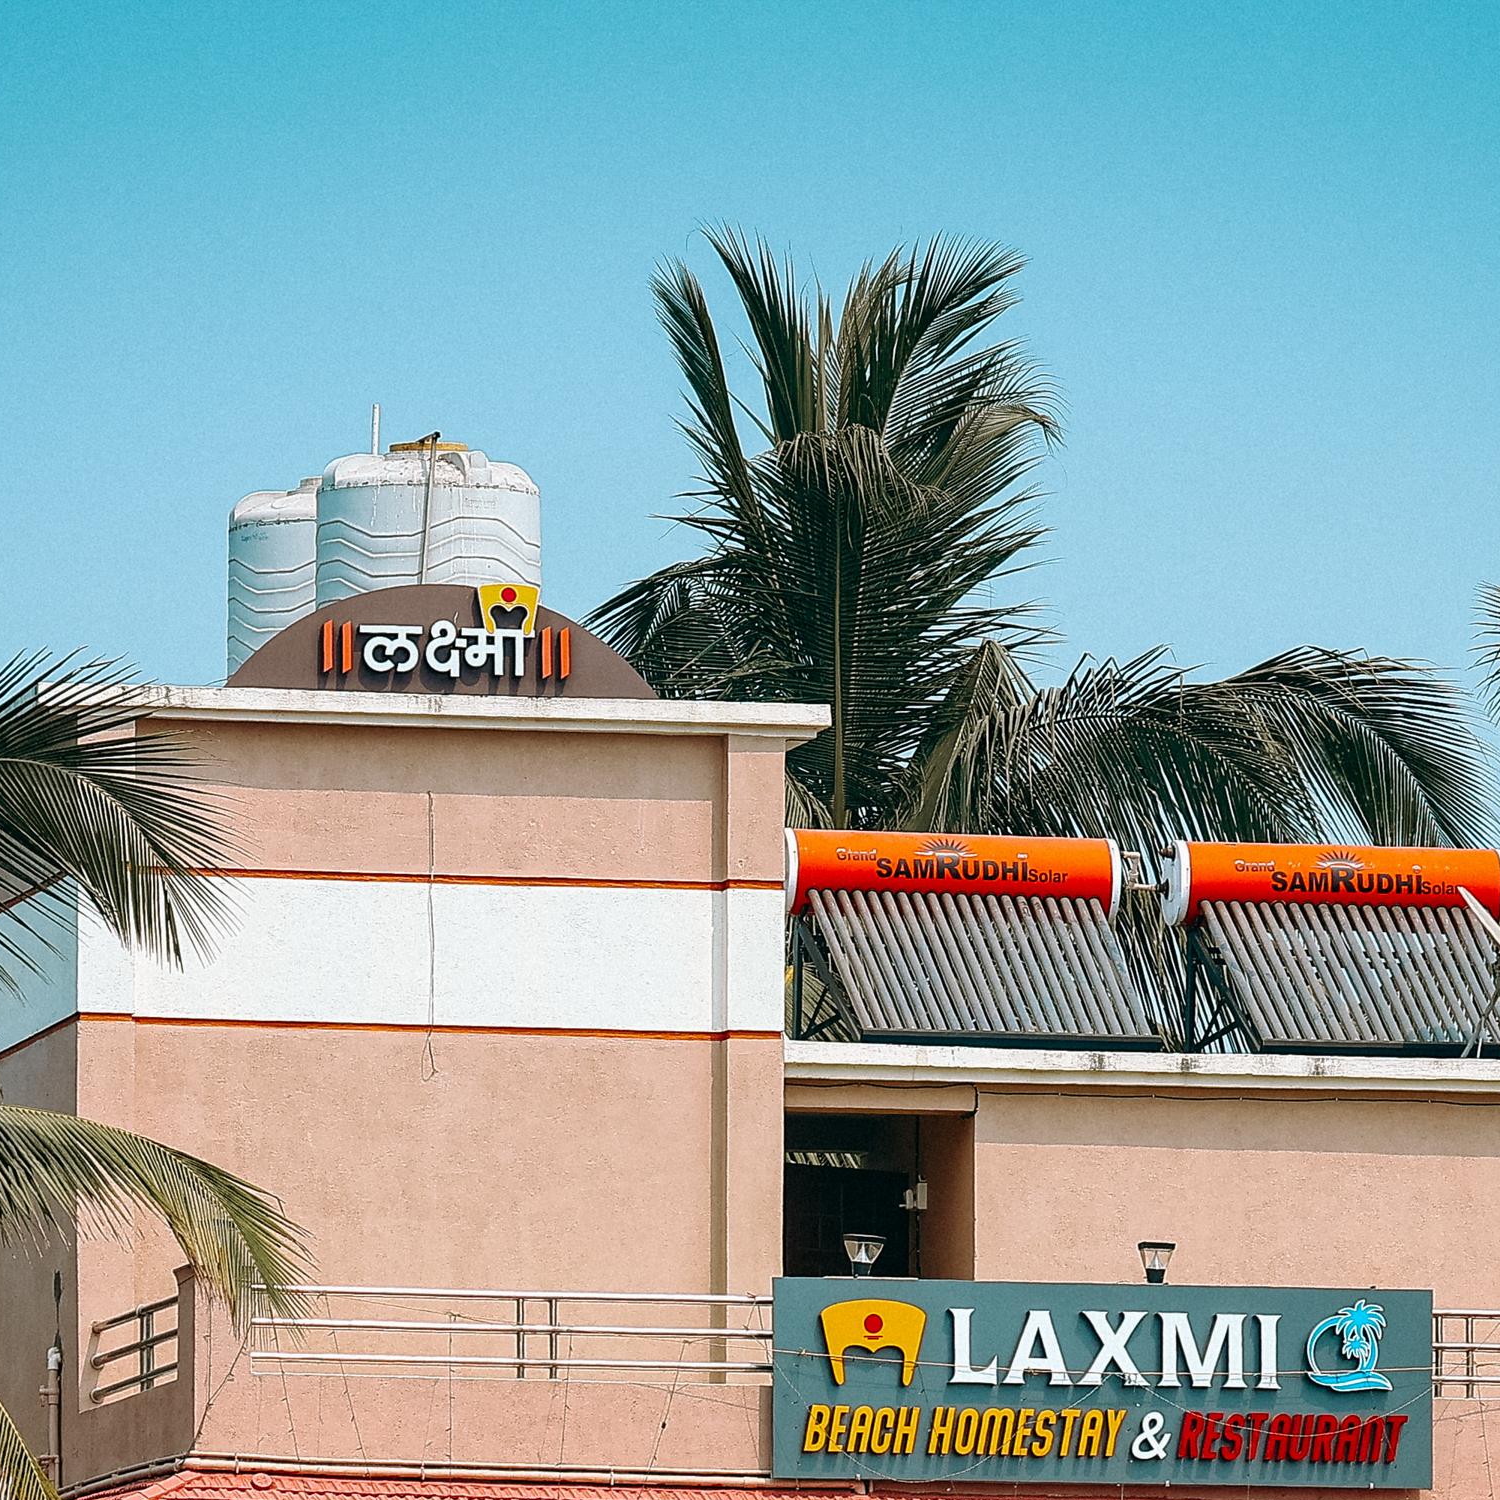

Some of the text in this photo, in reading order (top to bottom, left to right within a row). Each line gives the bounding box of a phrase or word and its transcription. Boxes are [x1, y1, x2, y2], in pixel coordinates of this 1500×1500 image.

[836, 847, 877, 861] Grand
[1028, 868, 1069, 883] Solar
[1234, 859, 1275, 872] Grand
[946, 1307, 1283, 1390] LAXMI
[802, 1403, 1409, 1463] BEACH HOMESTAY & RESTAURANT
